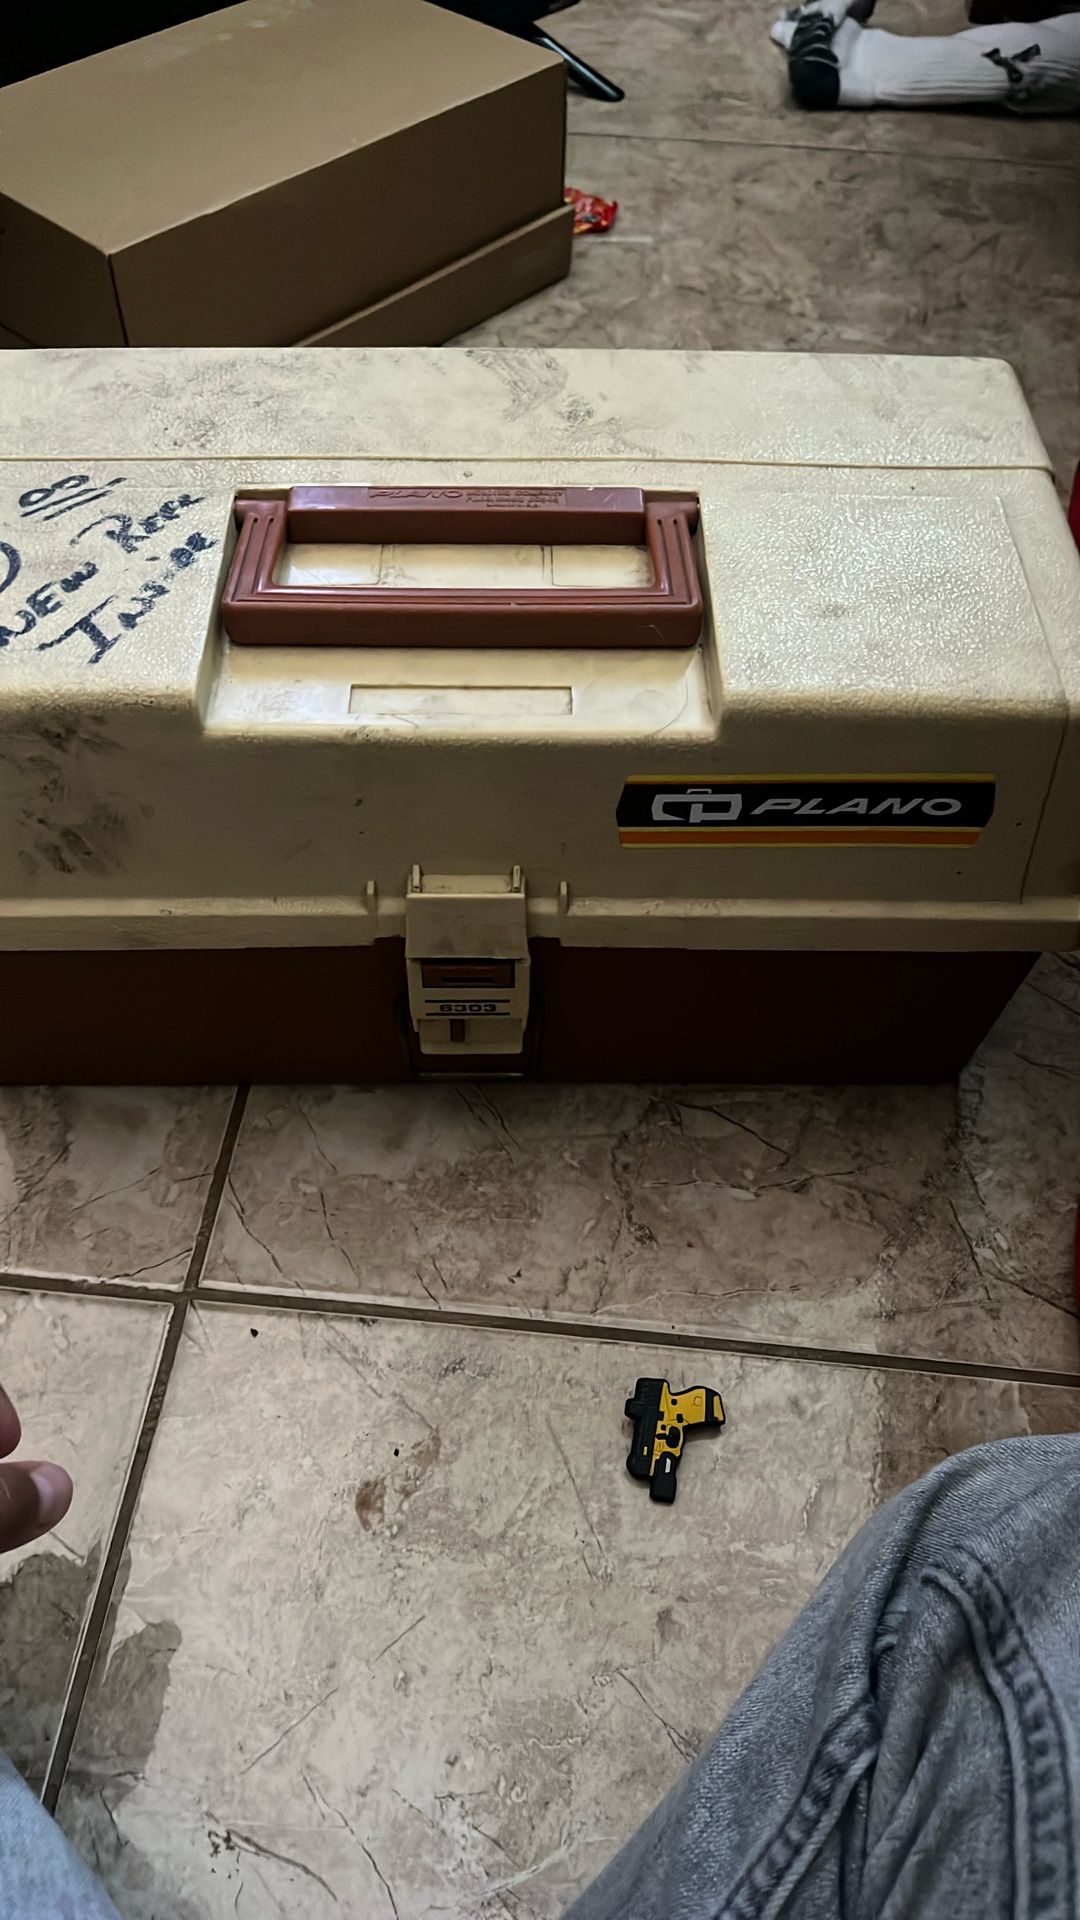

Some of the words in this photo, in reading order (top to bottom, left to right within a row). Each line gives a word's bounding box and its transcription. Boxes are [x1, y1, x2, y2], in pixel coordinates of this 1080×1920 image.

[368, 490, 463, 499] PLANO
[750, 797, 963, 816] PLANO
[439, 1003, 497, 1013] 6303
